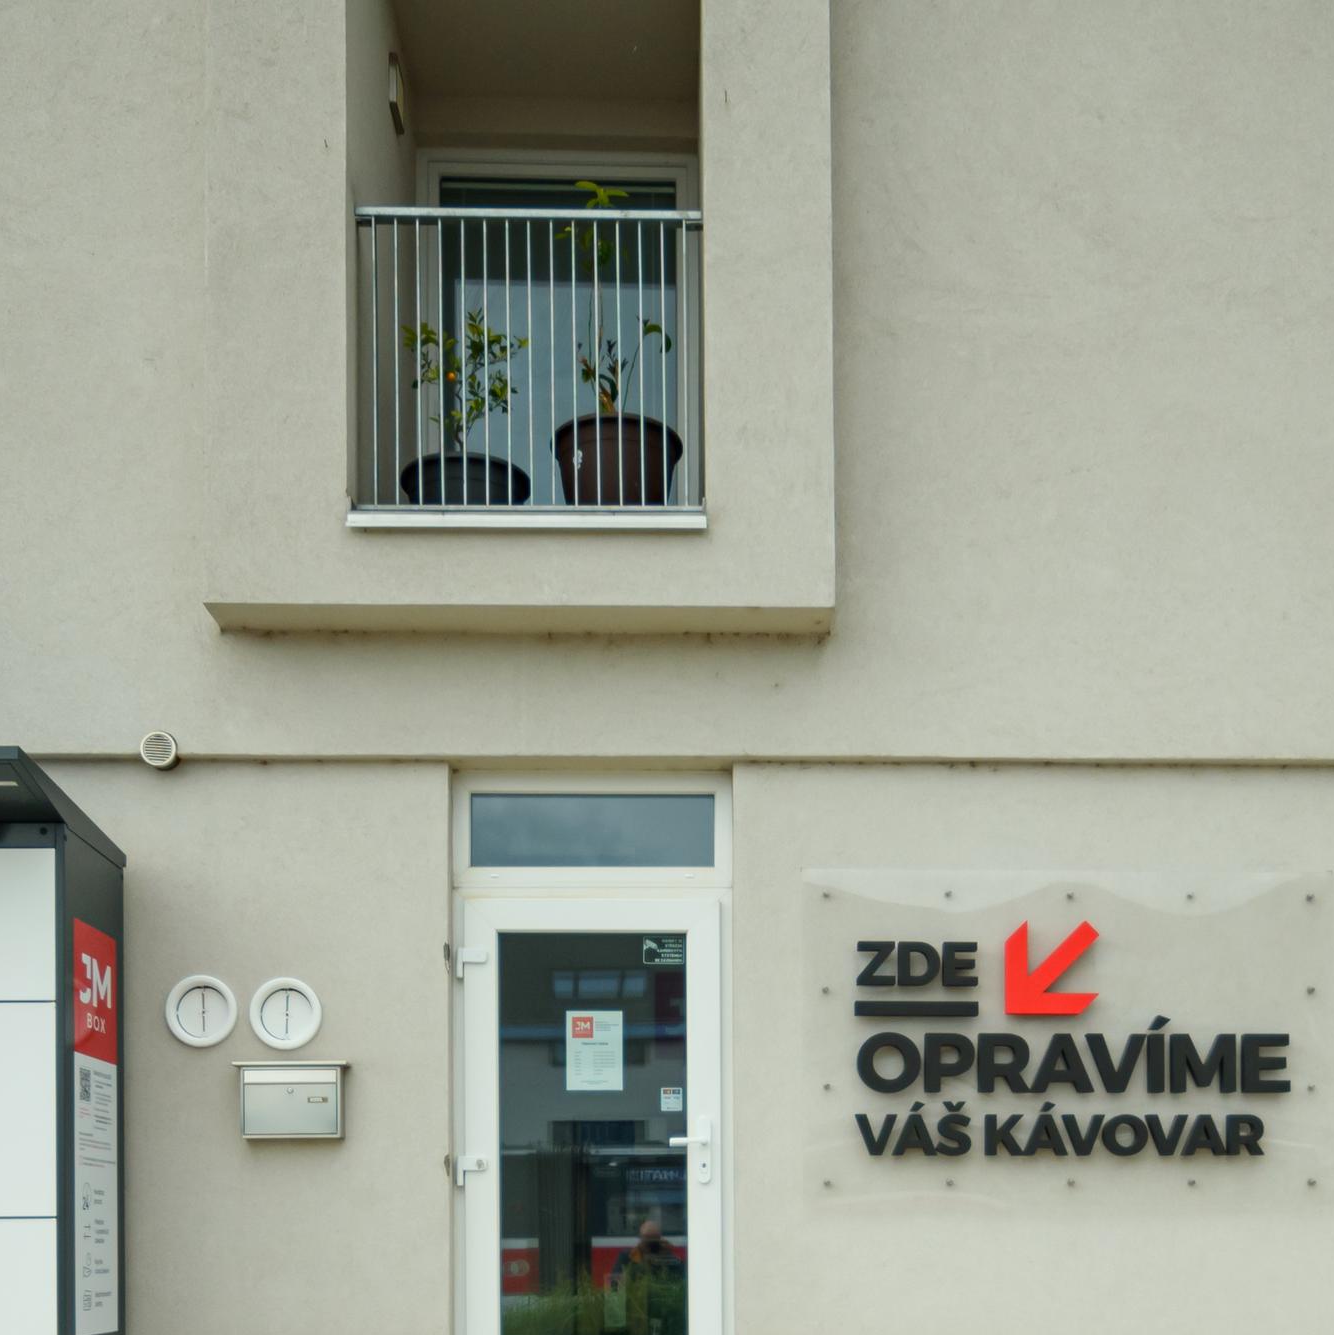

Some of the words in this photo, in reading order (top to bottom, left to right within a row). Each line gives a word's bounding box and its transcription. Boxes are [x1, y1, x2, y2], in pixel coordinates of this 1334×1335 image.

[79, 953, 112, 1009] JM
[856, 941, 979, 988] ZDE
[86, 1012, 107, 1034] BOX
[855, 1013, 1292, 1095] OPRAVÍME
[855, 1101, 971, 1157] VÁŠ
[983, 1101, 1265, 1157] KÁVOVAR
